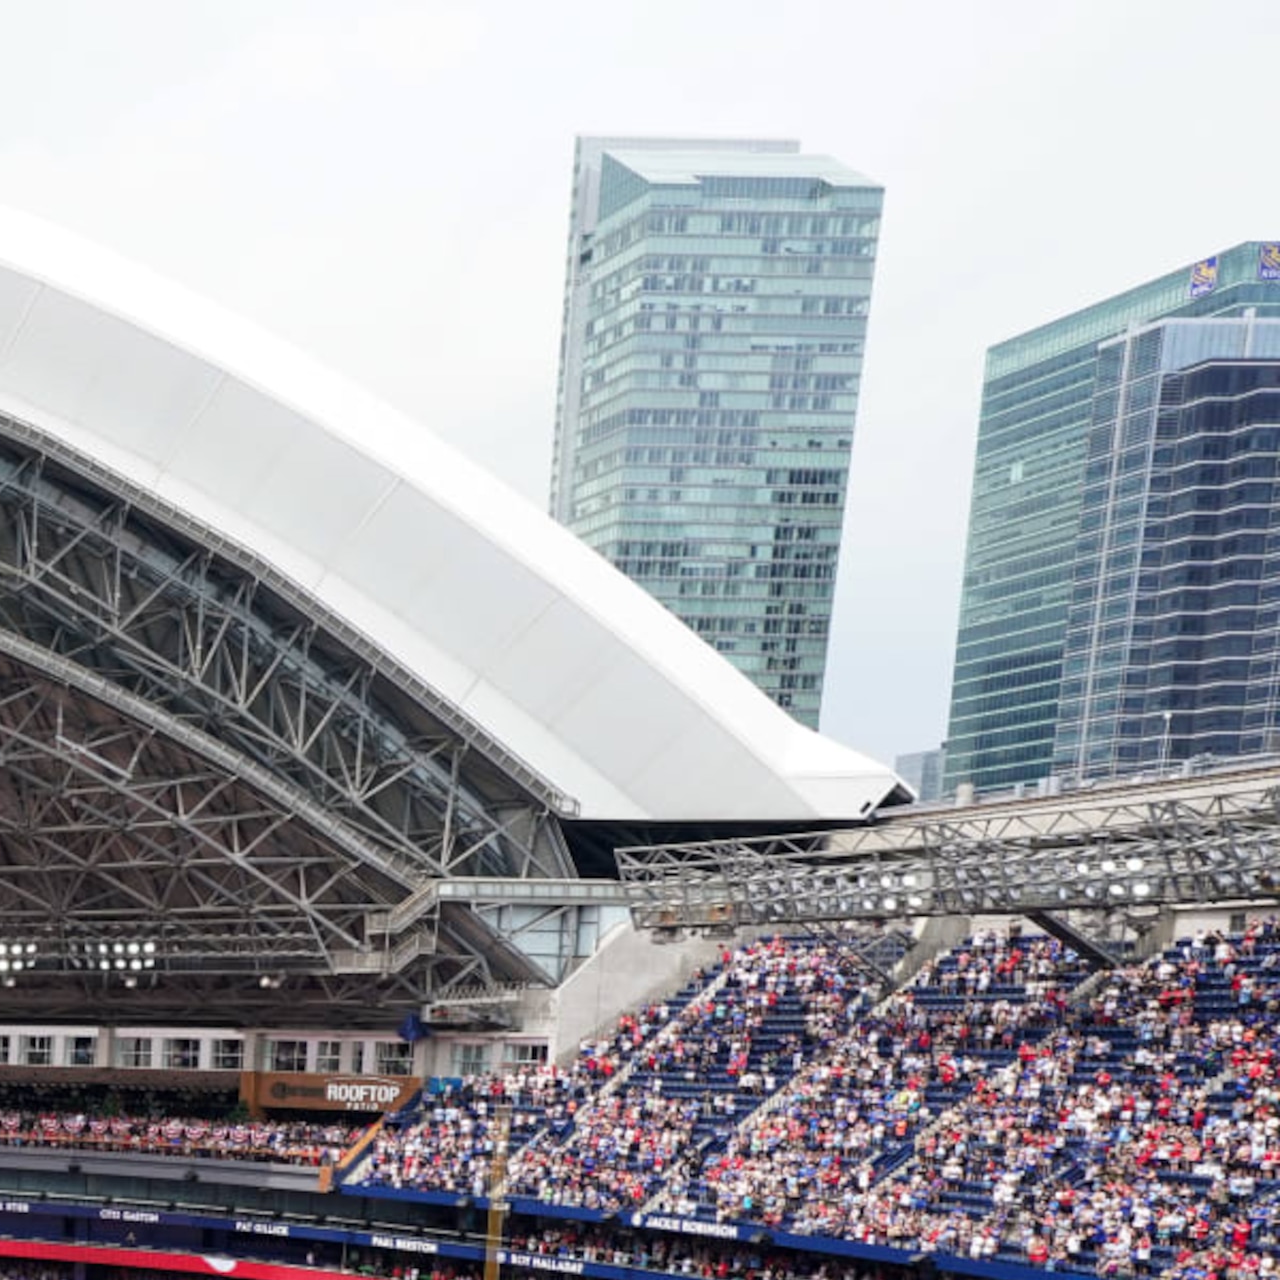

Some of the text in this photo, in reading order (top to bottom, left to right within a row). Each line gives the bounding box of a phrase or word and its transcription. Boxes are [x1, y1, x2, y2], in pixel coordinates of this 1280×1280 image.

[327, 1083, 401, 1102] ROOFTOP
[645, 1215, 739, 1238] JACKIE ROBINSON
